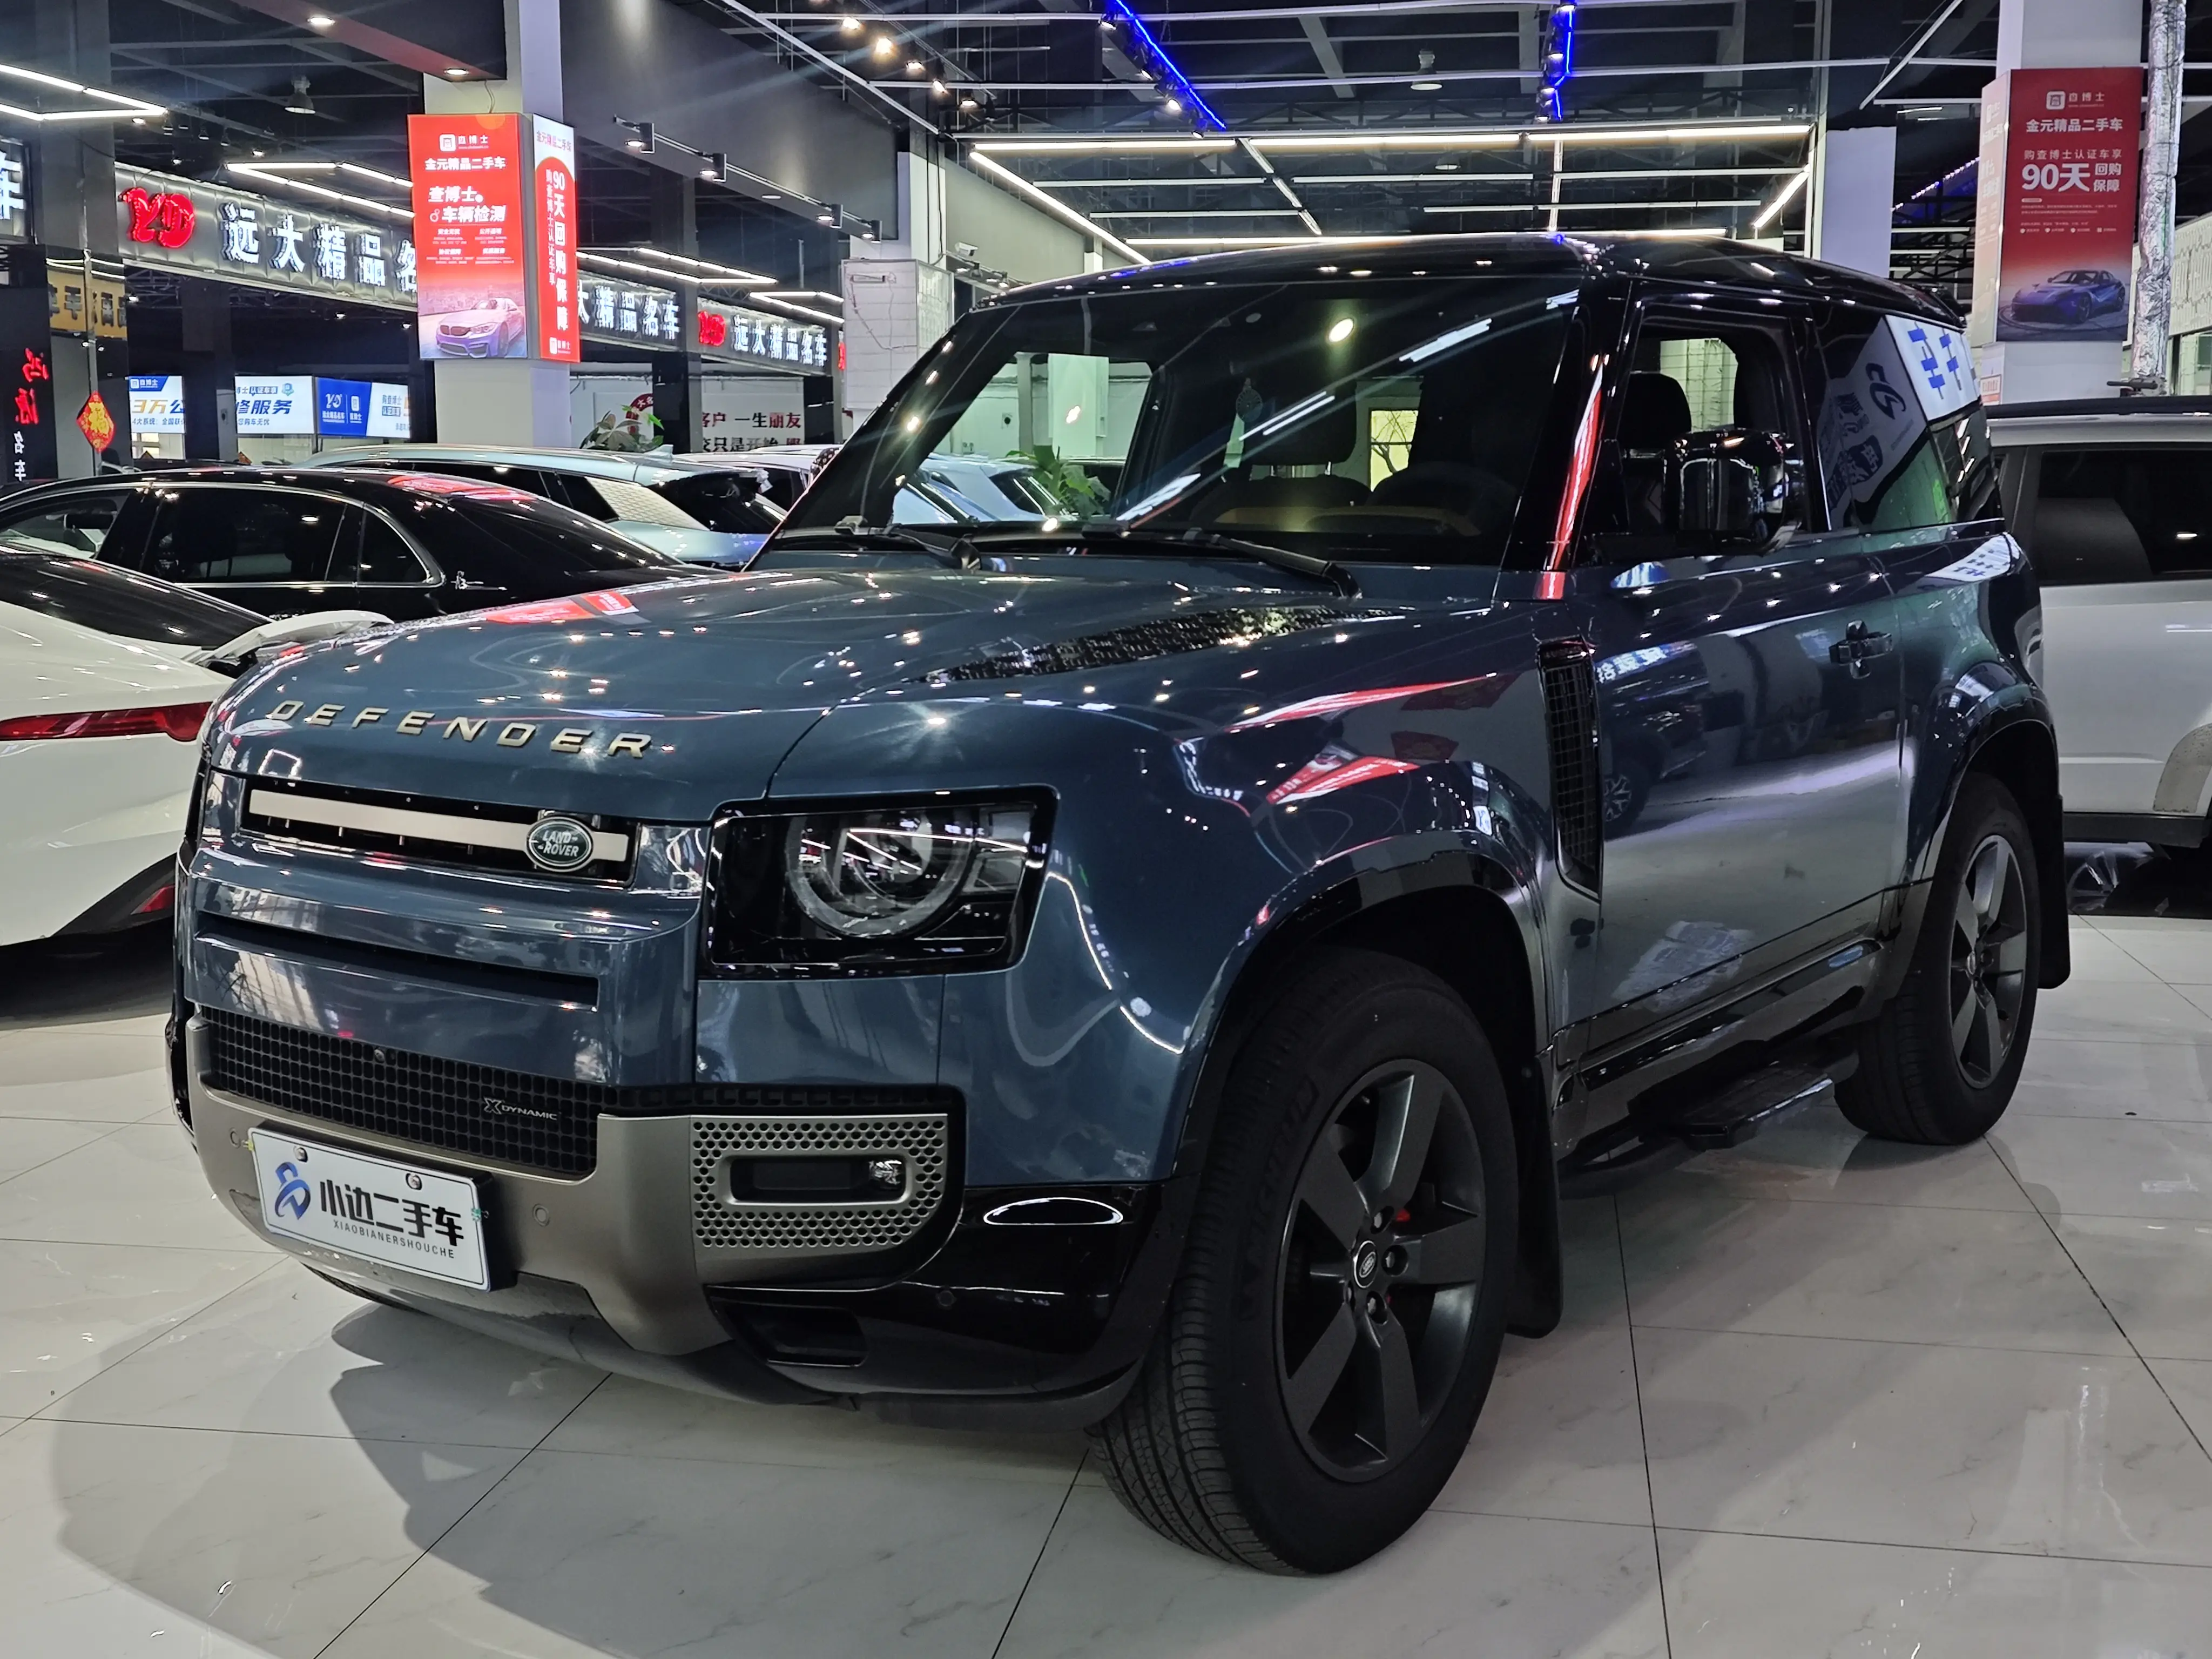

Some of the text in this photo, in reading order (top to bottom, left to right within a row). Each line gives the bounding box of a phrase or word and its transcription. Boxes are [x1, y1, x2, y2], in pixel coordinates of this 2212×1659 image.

[2026, 118, 2123, 132] 金元精品二手车
[2024, 149, 2122, 160] 购查博士认证车享
[425, 156, 506, 171] 金元精品二手车
[2095, 163, 2121, 176] 回购
[2022, 163, 2090, 192] 90天
[2093, 179, 2120, 192] 保障
[428, 186, 477, 203] 查博士
[442, 205, 506, 222] 车辆检测
[552, 171, 569, 331] 90天回购保障
[732, 314, 827, 367] 远大精品名车
[236, 400, 292, 414] 修服务
[734, 412, 801, 428] 一生朋友
[266, 700, 652, 759] DEFENDER
[501, 1105, 557, 1121] DYNAMIC
[320, 1179, 464, 1246] 小边二手车
[333, 1219, 455, 1258] XIAOBIANERSHOUCHE
